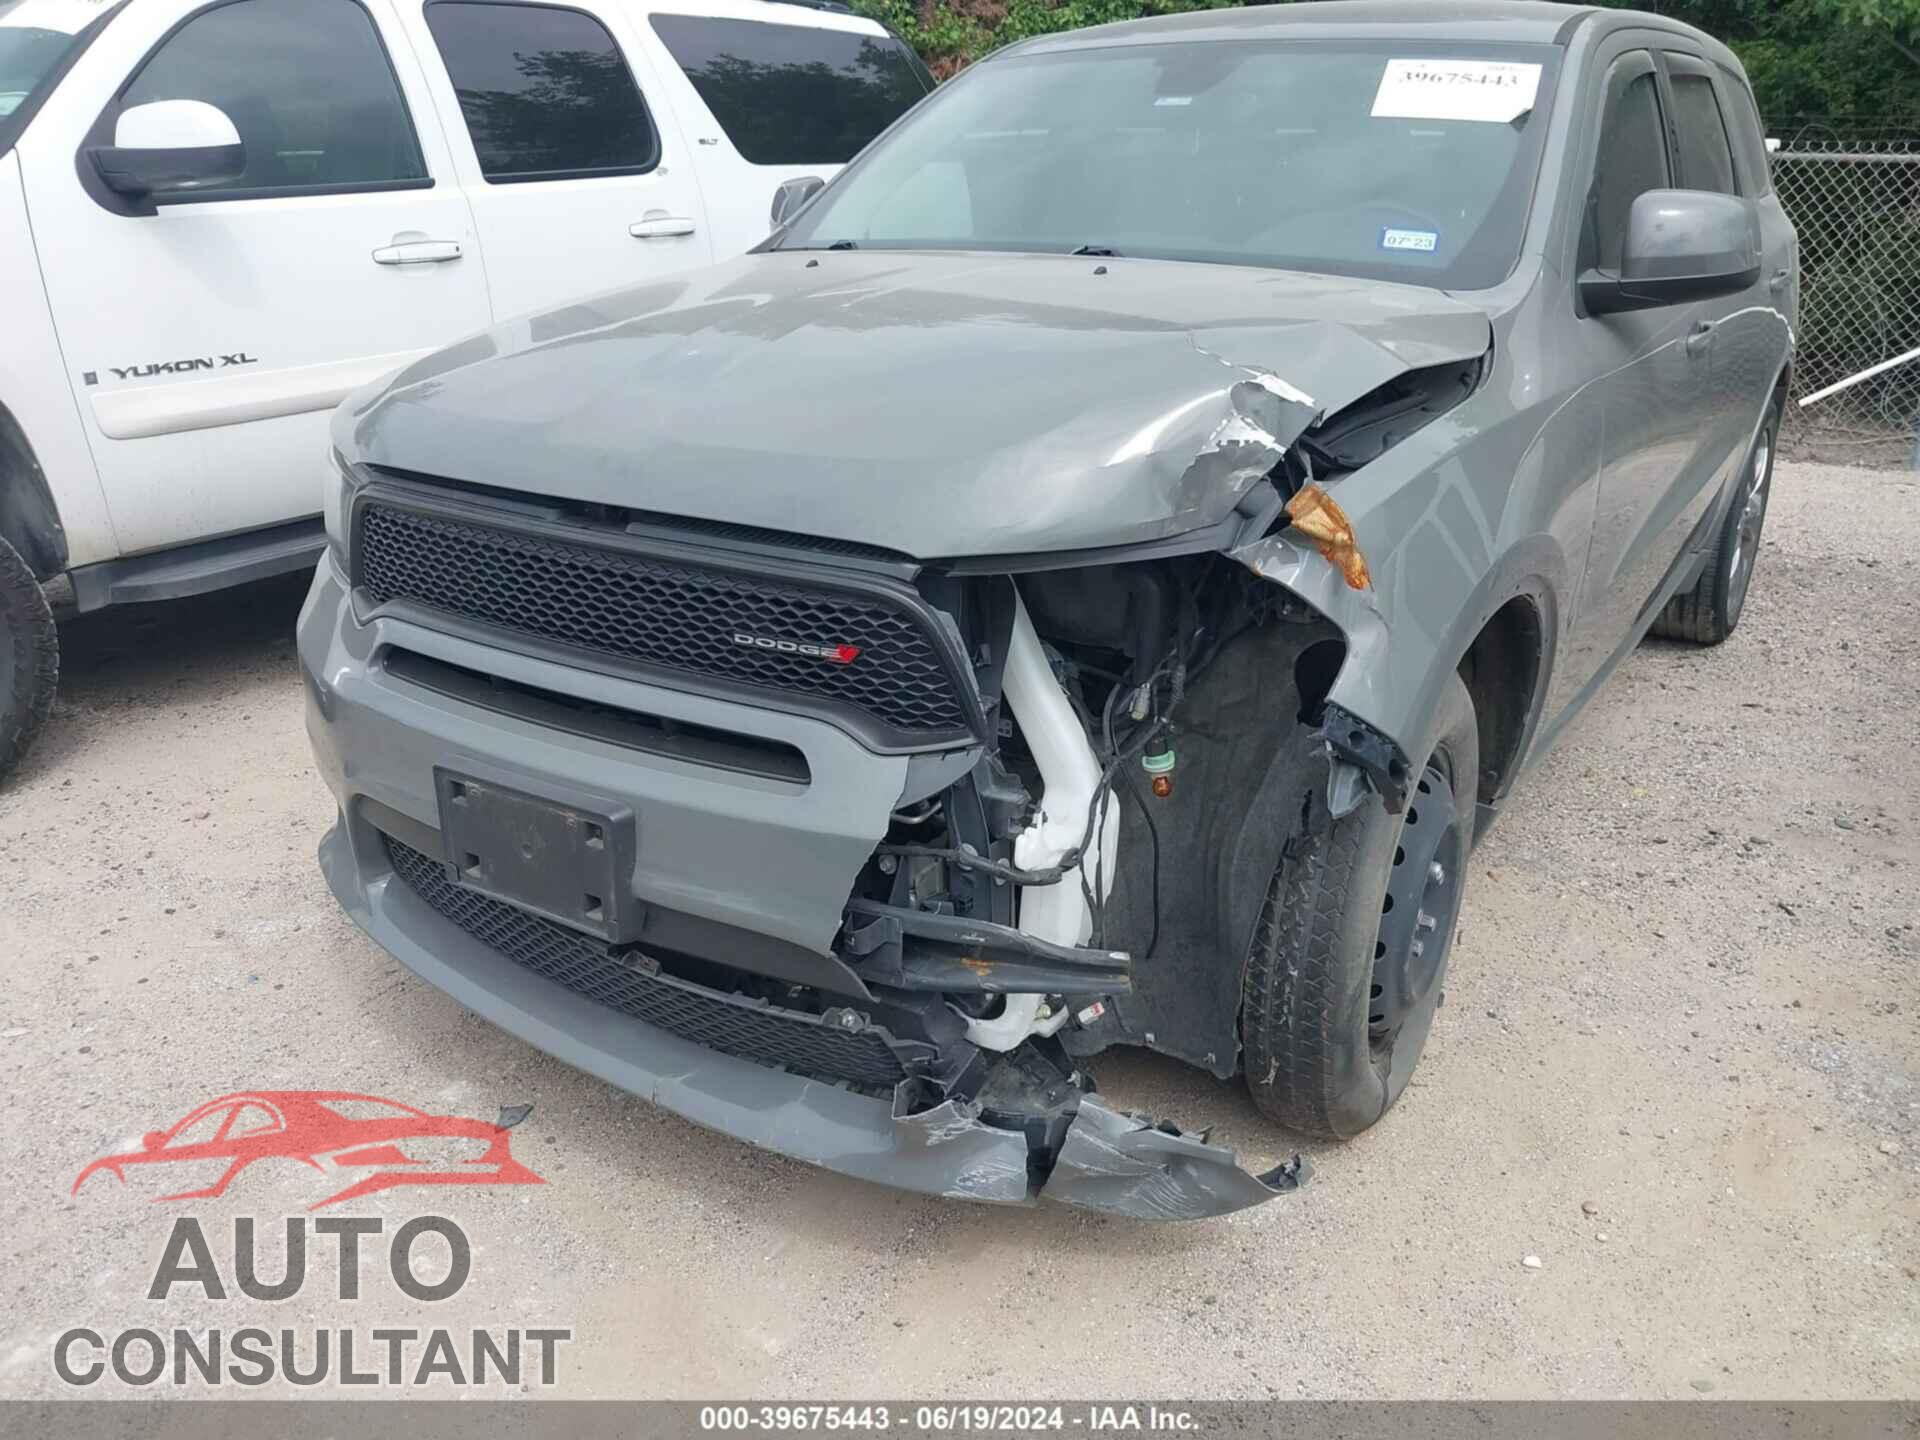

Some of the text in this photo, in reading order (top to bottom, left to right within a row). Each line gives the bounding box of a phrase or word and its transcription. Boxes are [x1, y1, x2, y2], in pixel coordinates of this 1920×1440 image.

[1398, 72, 1521, 88] 39675443
[109, 357, 214, 380] YUKON
[219, 352, 258, 368] XL
[733, 633, 842, 658] DODGE
